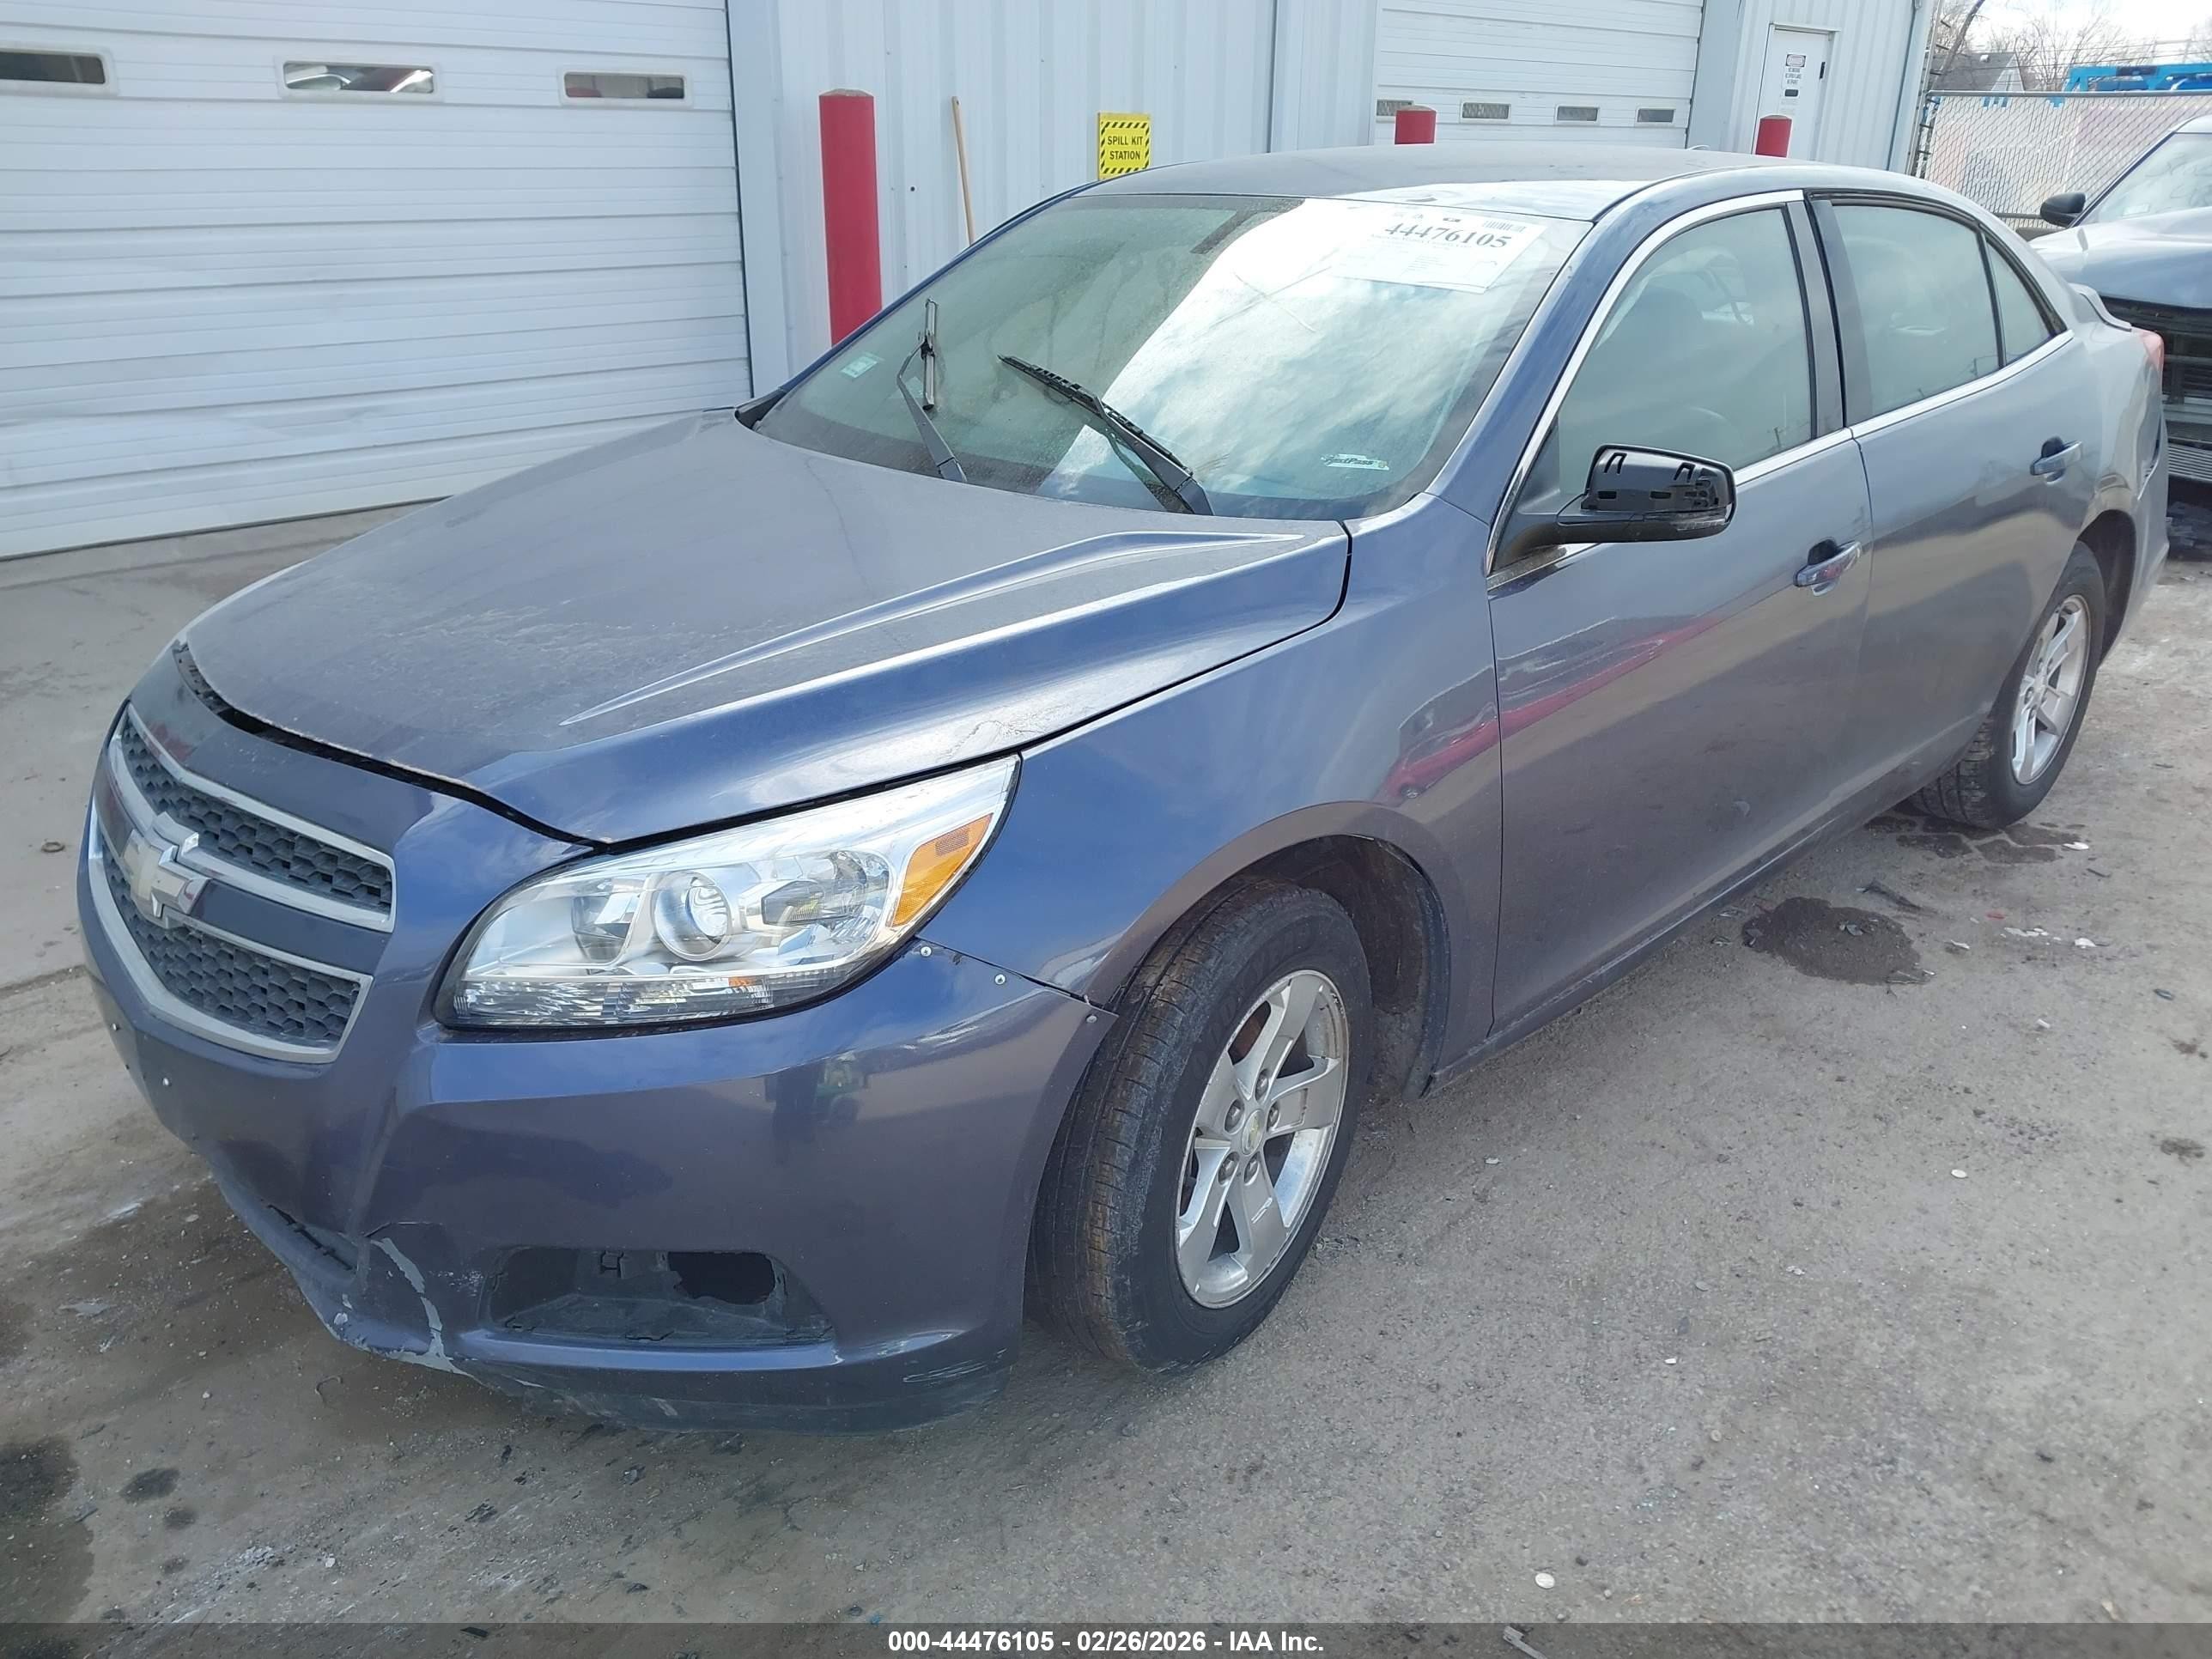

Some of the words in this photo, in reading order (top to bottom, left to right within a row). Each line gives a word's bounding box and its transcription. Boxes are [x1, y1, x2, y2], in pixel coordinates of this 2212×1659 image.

[1107, 136, 1128, 145] SPILL
[1131, 136, 1143, 145] KIT
[1109, 150, 1140, 160] STATION
[1385, 222, 1512, 248] 44476105
